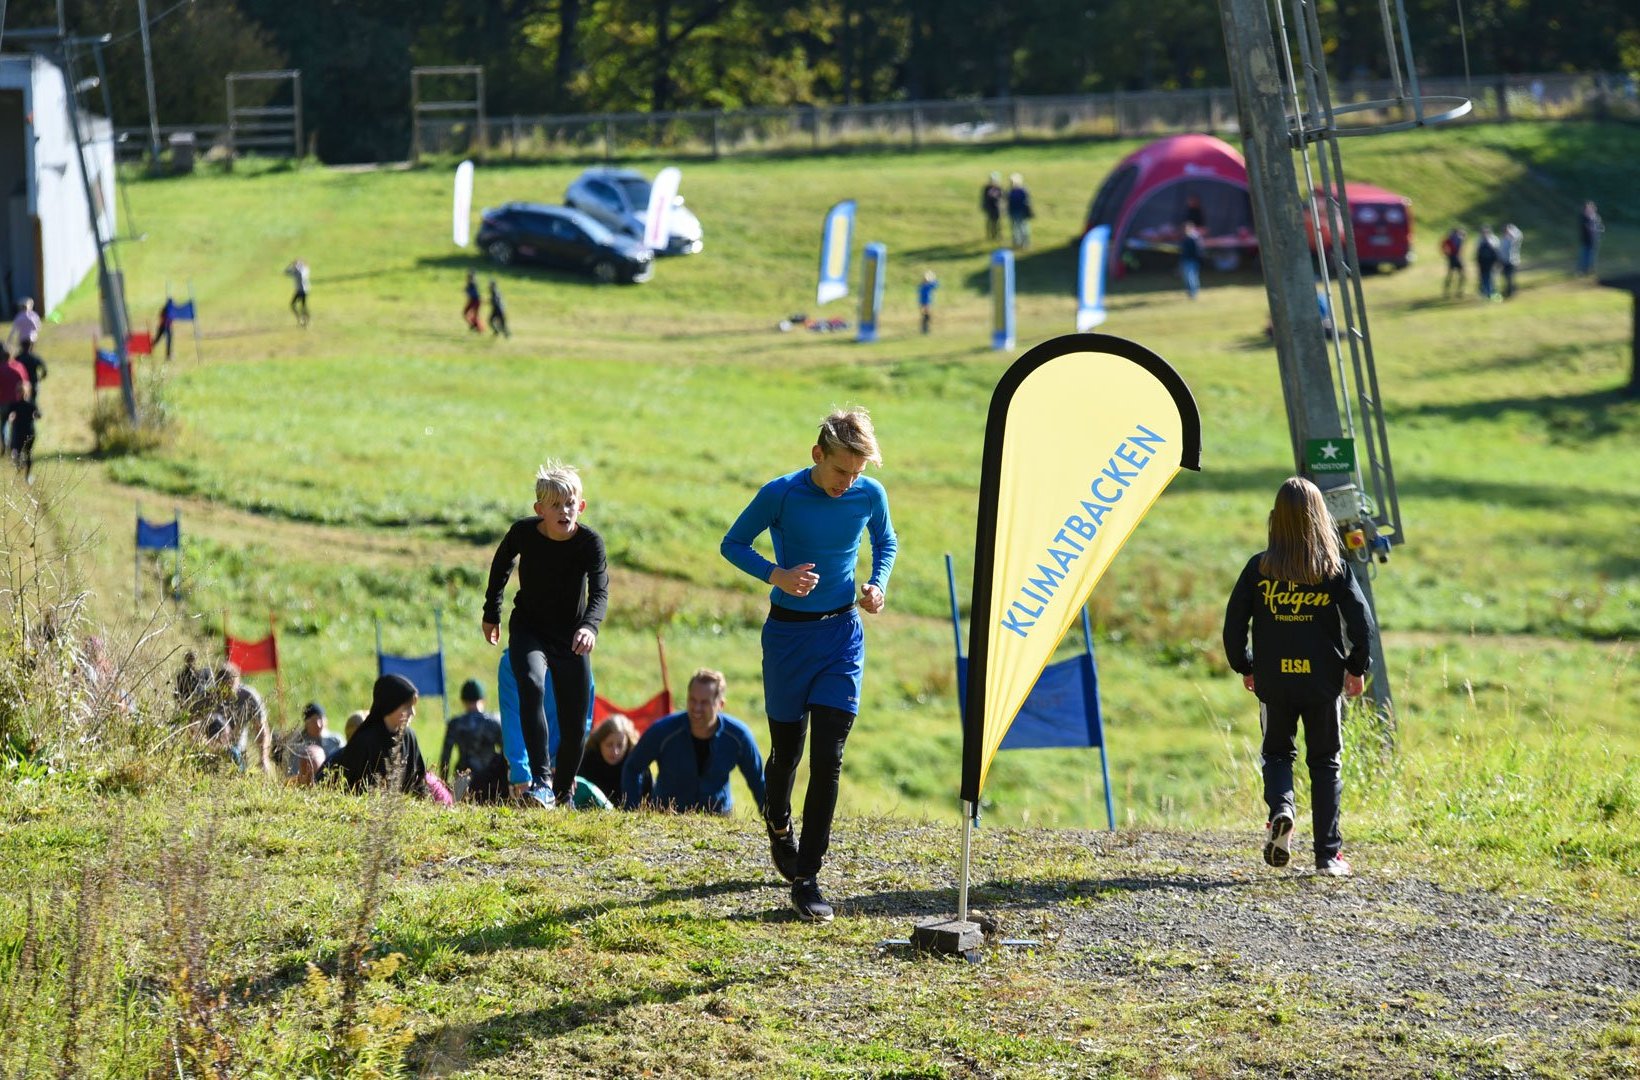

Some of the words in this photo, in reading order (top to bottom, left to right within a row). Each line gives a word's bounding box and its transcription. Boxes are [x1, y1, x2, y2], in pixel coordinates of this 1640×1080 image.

[1001, 424, 1166, 638] KLIMATBACKEN
[1257, 579, 1331, 614] Hagen
[1281, 659, 1311, 673] ELSA
